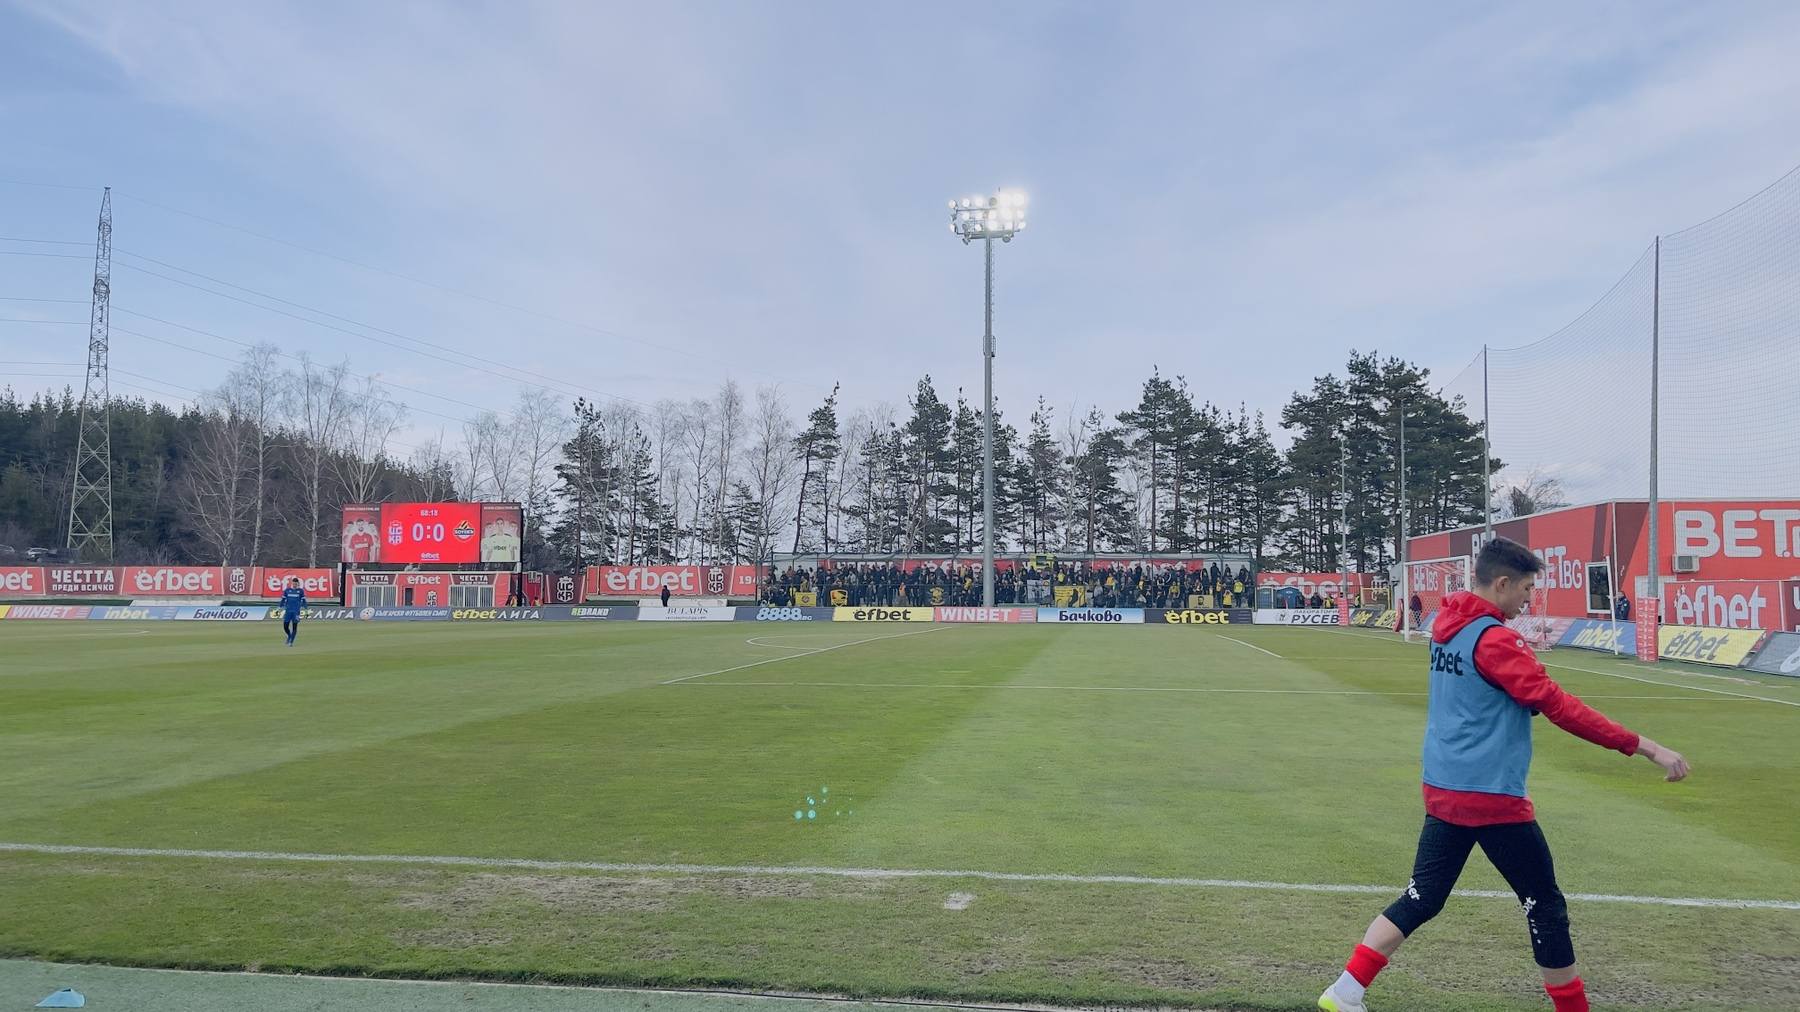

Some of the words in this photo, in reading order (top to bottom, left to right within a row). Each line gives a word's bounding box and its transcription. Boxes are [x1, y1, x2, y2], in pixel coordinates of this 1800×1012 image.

[412, 522, 445, 542] 0:0
[51, 570, 115, 583] ЧЕСТТА
[134, 569, 214, 591] efbet
[407, 575, 441, 585] efbet
[605, 567, 694, 591] efbet
[52, 584, 79, 592] ПРЕДИ
[12, 607, 73, 618] WINBET
[1674, 584, 1767, 629] efbet
[104, 607, 149, 619] inbet
[193, 608, 248, 620] Бачково
[315, 611, 354, 619] ЛИГА
[453, 608, 497, 619] efbet
[497, 610, 540, 619] ЛИГА
[853, 608, 911, 621] efbet
[941, 608, 1012, 621] WINBET
[1059, 610, 1122, 622] Бачково
[1165, 610, 1230, 623] efbet
